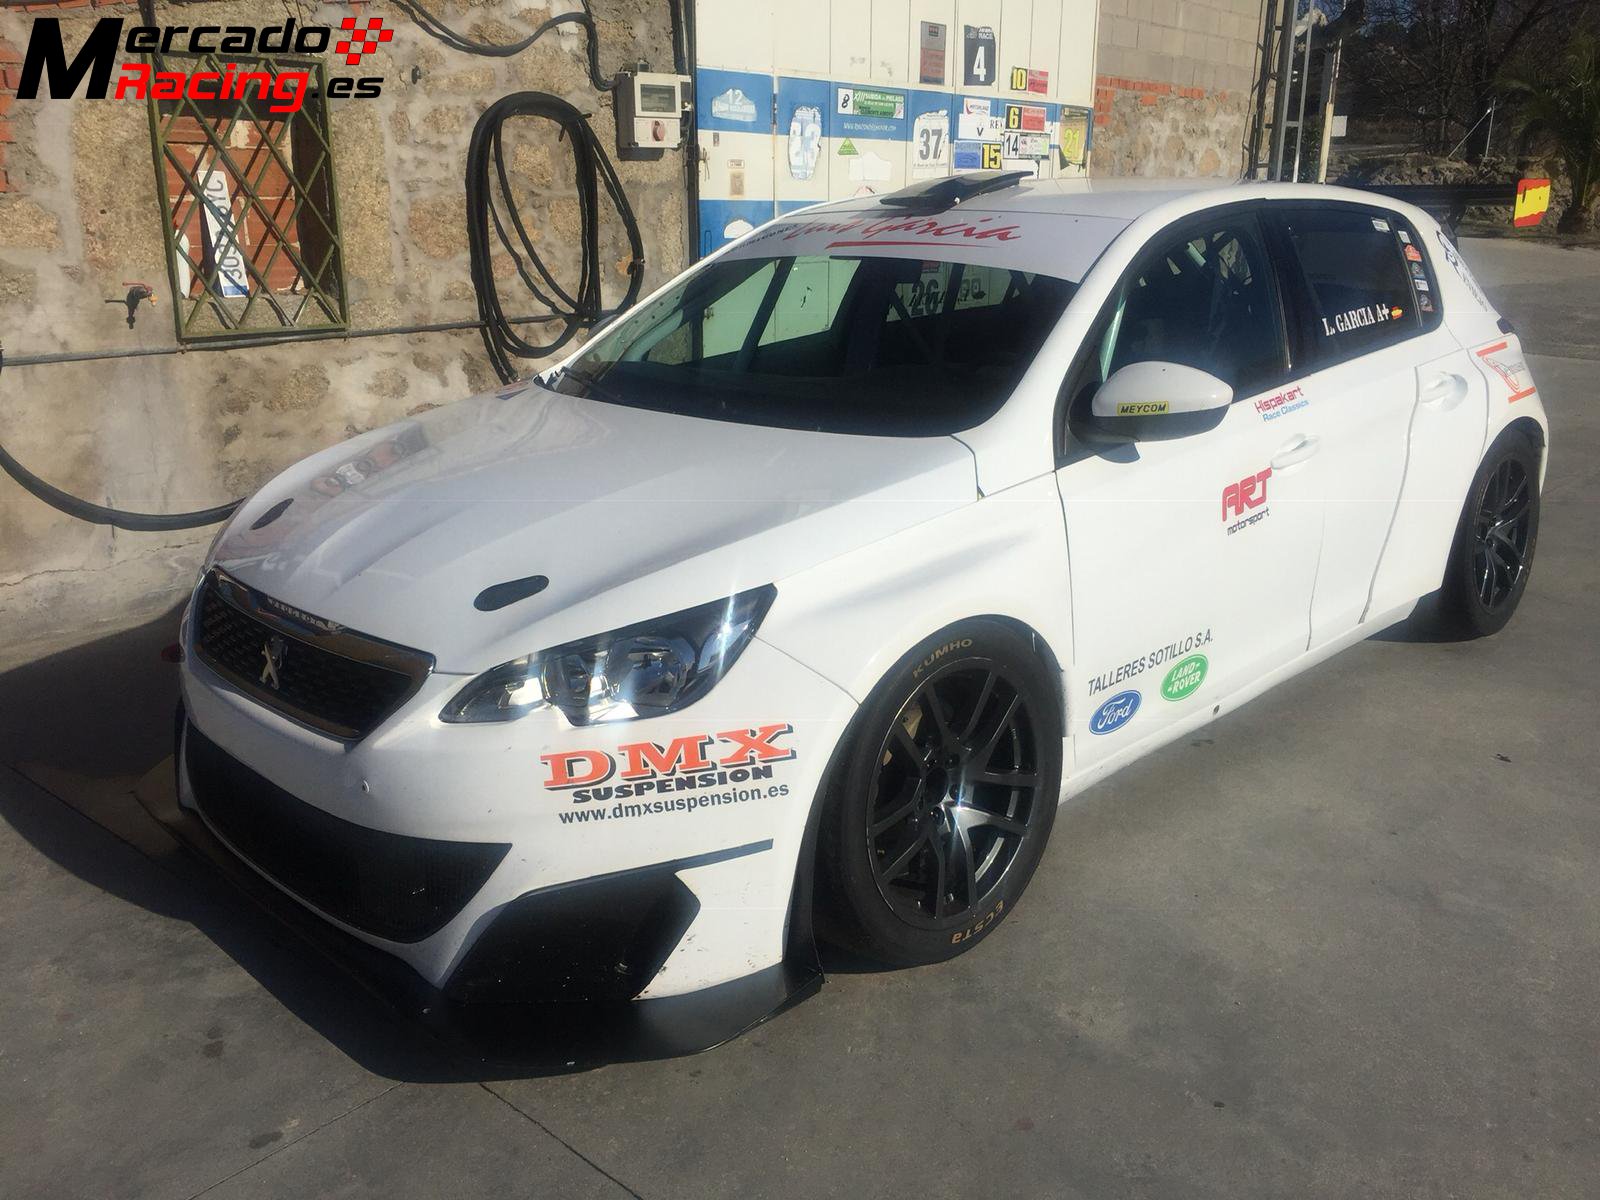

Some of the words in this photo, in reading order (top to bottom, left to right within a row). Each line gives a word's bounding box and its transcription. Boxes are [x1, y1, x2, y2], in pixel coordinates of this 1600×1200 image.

[973, 46, 986, 82] 4
[1012, 68, 1026, 90] 10
[841, 93, 850, 108] 8
[976, 127, 984, 137] V
[1009, 106, 1020, 129] 6
[919, 128, 943, 160] 37
[983, 144, 1001, 169] 15
[1005, 133, 1019, 157] 14
[1335, 306, 1376, 333] GARCIA
[1376, 303, 1390, 322] A+
[1119, 403, 1167, 414] MEYCOM
[1254, 386, 1304, 414] Hispakart
[1262, 410, 1281, 422] Race
[1281, 399, 1309, 415] Classics
[1222, 467, 1272, 522] ART
[1227, 506, 1270, 537] motorsport
[912, 638, 973, 679] KUMHO
[1088, 656, 1146, 697] TALLERES
[1148, 636, 1193, 669] SOTILLO
[1194, 628, 1213, 649] S.A.
[1097, 697, 1134, 730] Ford
[540, 723, 797, 791] DMX
[572, 764, 774, 804] SUSPENSION
[558, 783, 790, 825] www.dmxsuspension.es
